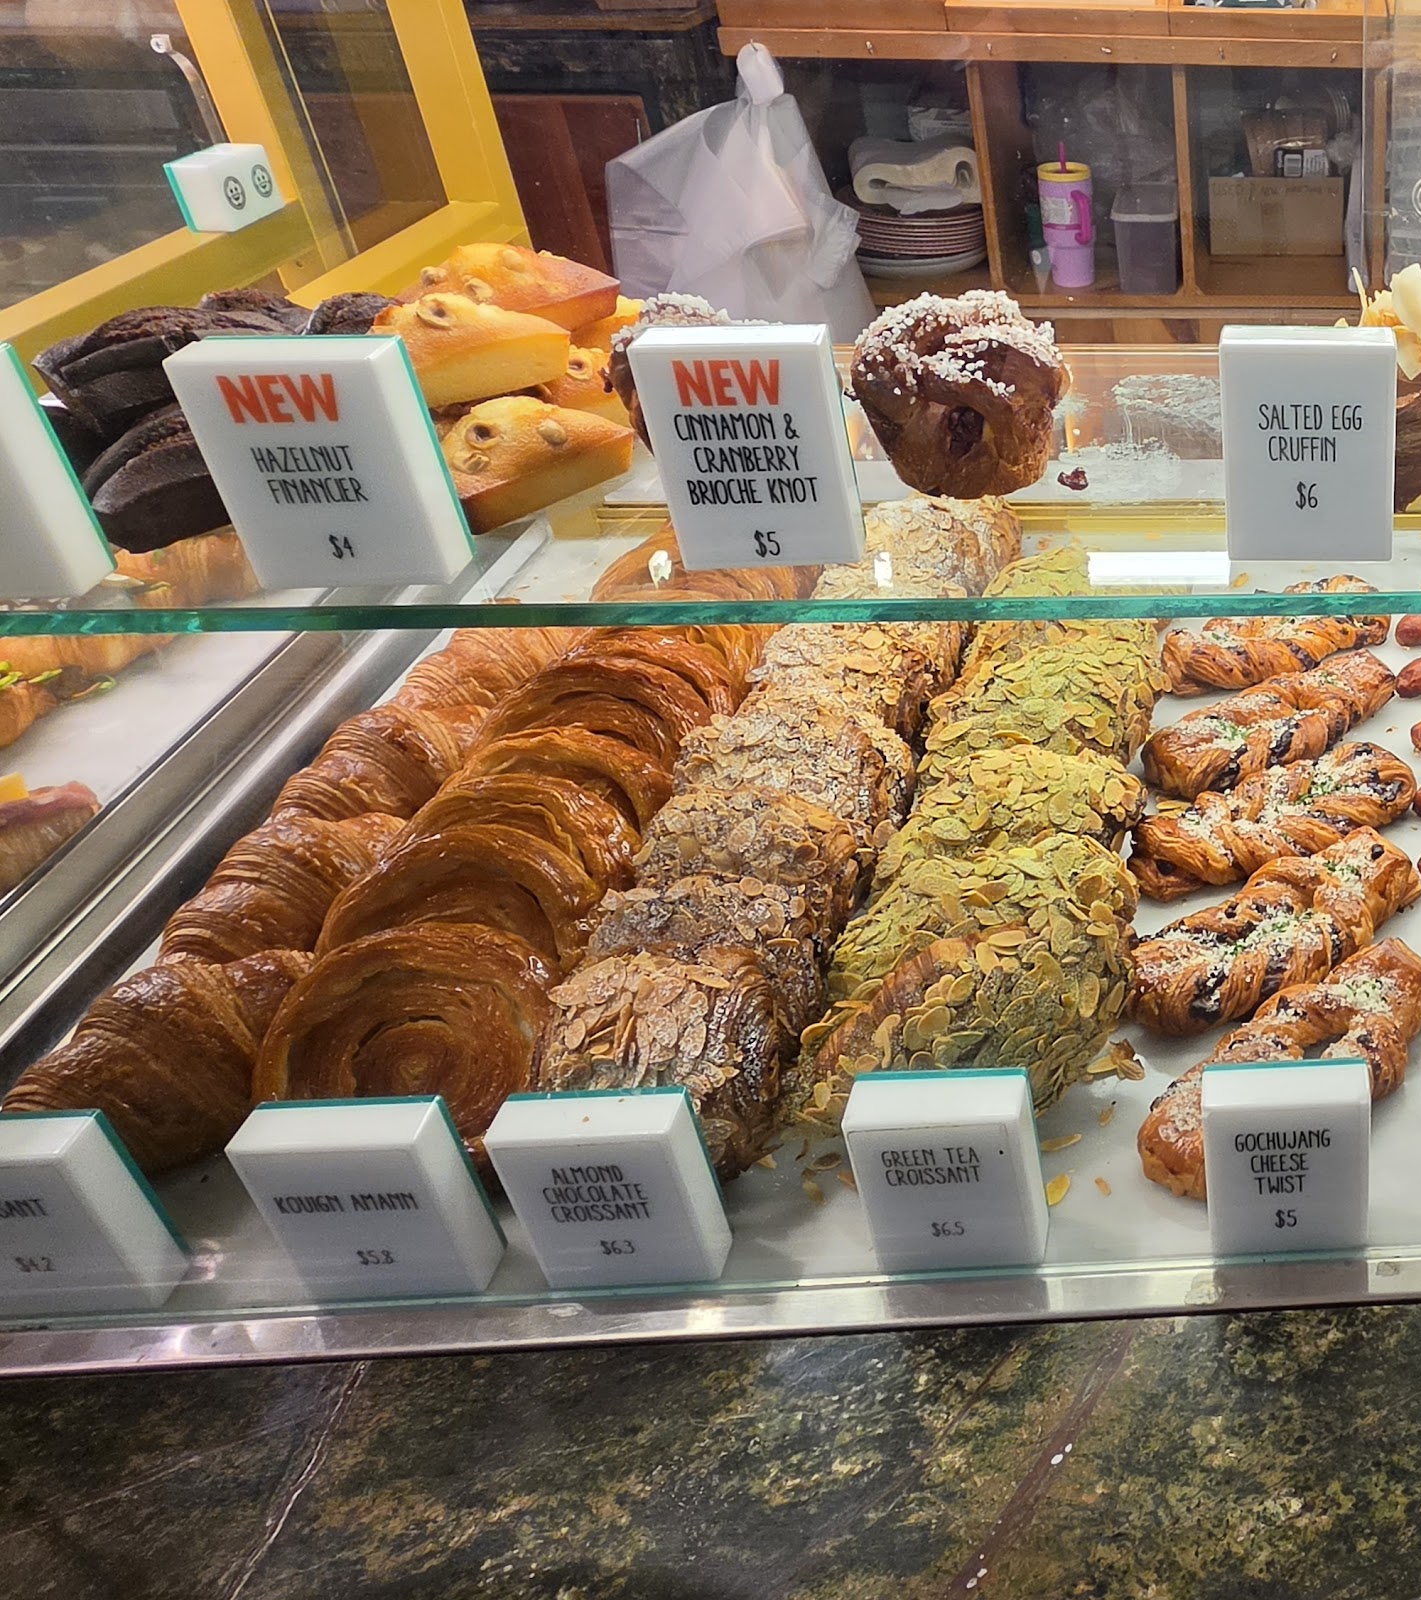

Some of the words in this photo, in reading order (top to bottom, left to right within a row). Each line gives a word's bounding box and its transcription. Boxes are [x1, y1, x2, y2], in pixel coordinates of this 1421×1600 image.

[671, 359, 780, 407] NEW
[215, 373, 340, 425] NEW
[674, 413, 776, 441] CINNAMON
[784, 413, 800, 440] &
[1258, 404, 1323, 431] SALTED
[1332, 405, 1362, 431] EGG
[250, 445, 354, 473] HAZELNUT
[694, 445, 800, 473] CRANBERRY
[1268, 436, 1336, 462] CRUFFIN
[267, 478, 369, 504] FINANCIER
[687, 478, 763, 505] BRIOCHE
[767, 477, 818, 504] KNOT
[1295, 481, 1318, 510] $6
[328, 534, 355, 560] $4
[754, 530, 781, 558] $5
[1234, 1129, 1331, 1152] GOCHUJANG
[881, 1148, 937, 1168] GREEN
[943, 1147, 980, 1165] TEA
[1250, 1153, 1309, 1174] CHEESE
[551, 1165, 624, 1185] ALMOND
[885, 1165, 980, 1187] CROISSANT
[1254, 1174, 1306, 1195] TWIST
[273, 1194, 345, 1214] KOUIGN
[350, 1192, 419, 1211] AMANN
[542, 1183, 648, 1205] CHOCOLATE
[551, 1201, 650, 1223] CROISSANT
[1275, 1210, 1297, 1228] $5
[930, 1221, 965, 1237] $6.5
